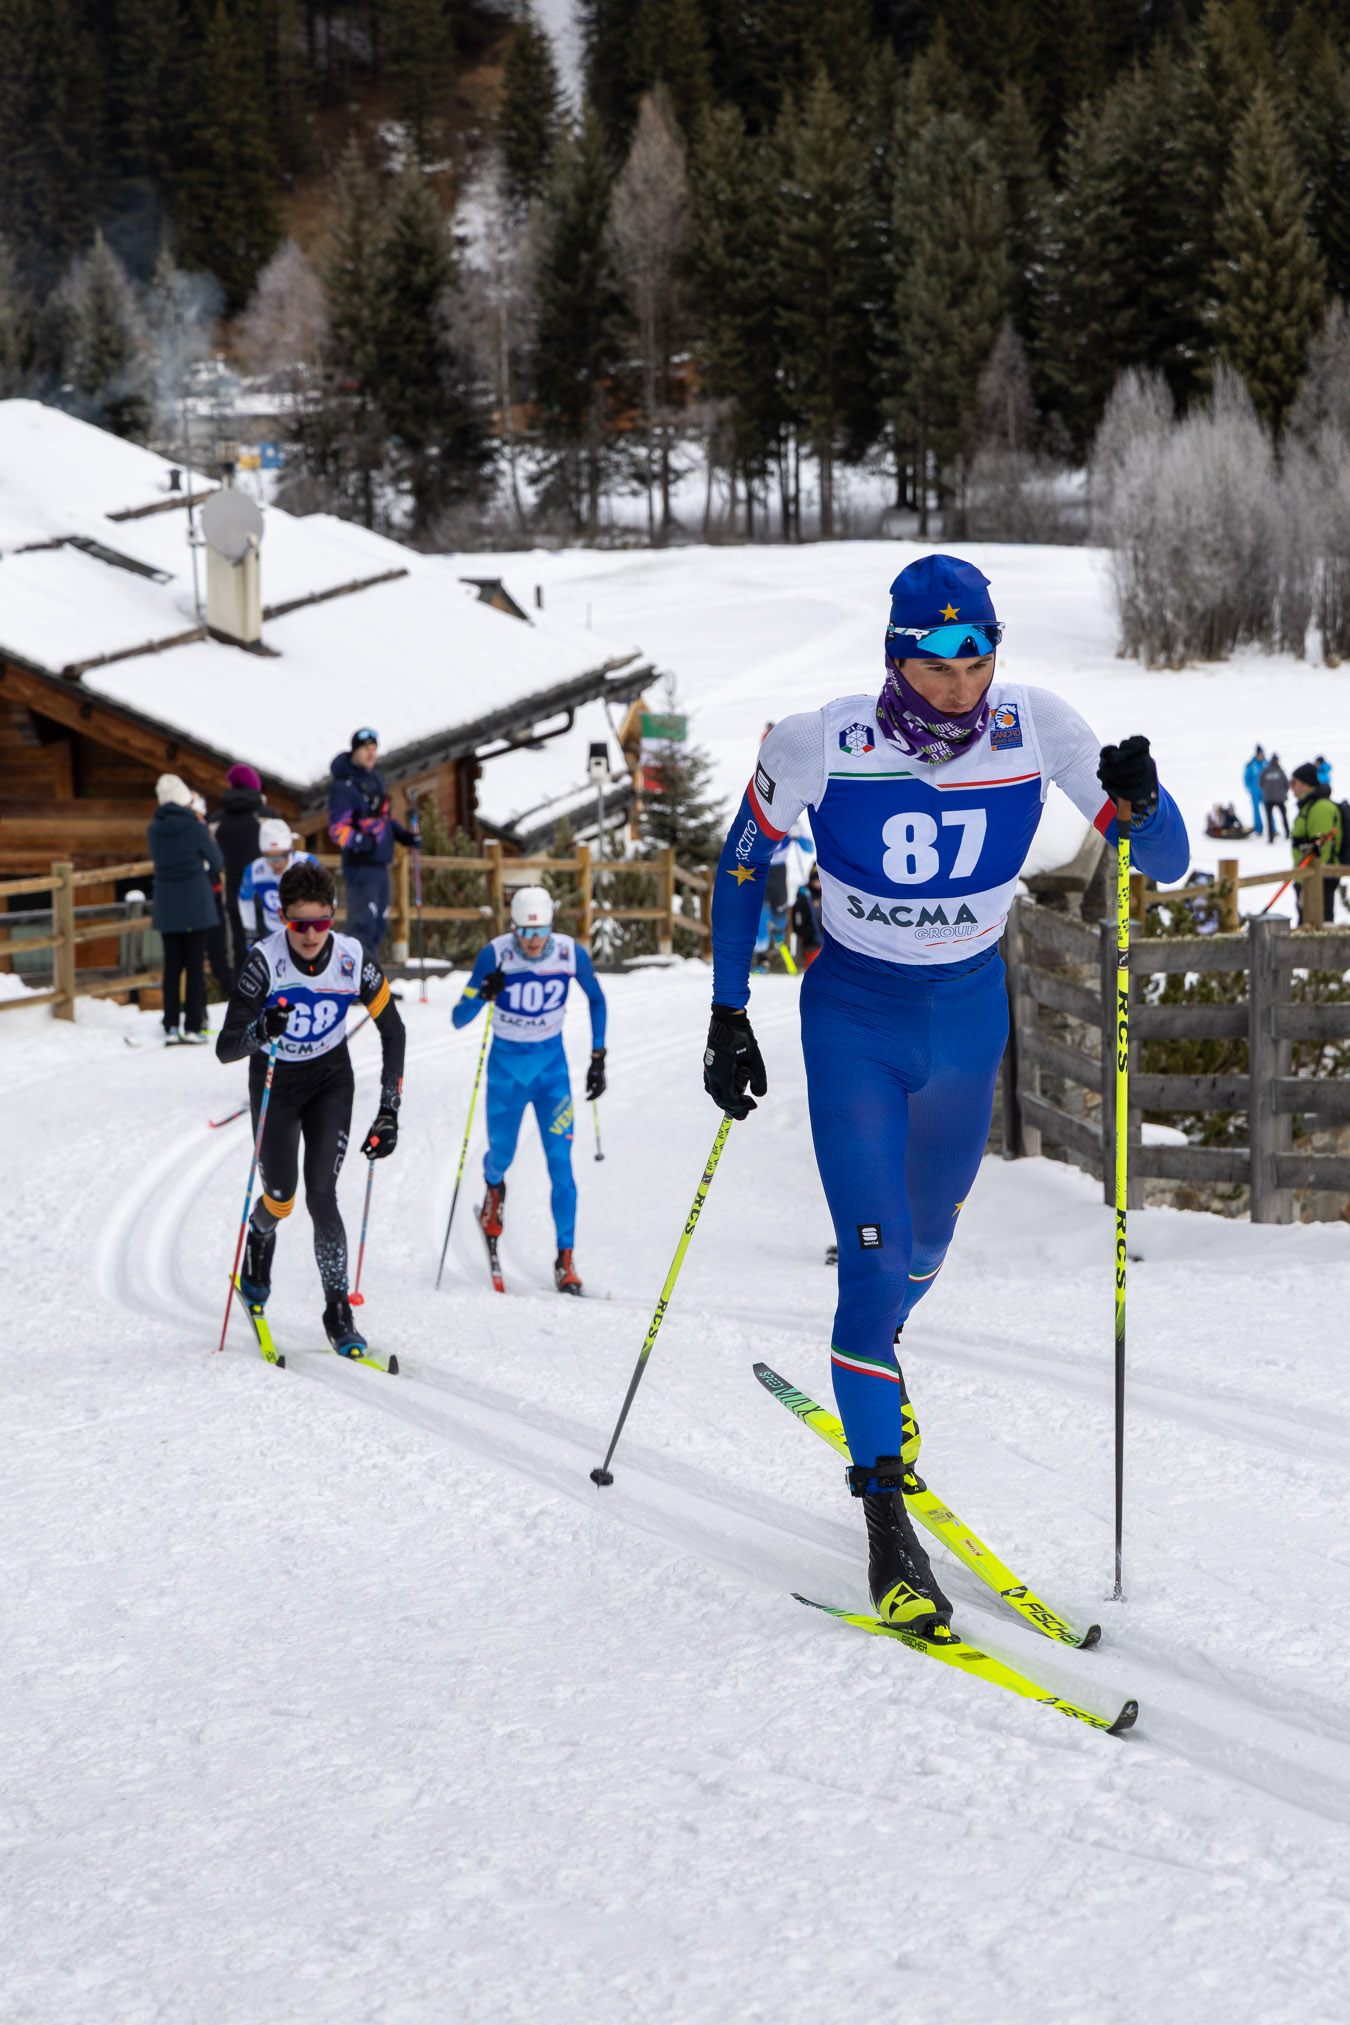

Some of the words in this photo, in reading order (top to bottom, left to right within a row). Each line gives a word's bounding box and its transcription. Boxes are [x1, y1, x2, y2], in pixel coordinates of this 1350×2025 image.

[845, 724, 867, 734] FISI
[928, 722, 957, 733] MOVE
[991, 729, 1021, 740] CANCRO
[921, 740, 949, 755] MOVE
[882, 808, 987, 885] 87
[847, 895, 978, 928] SACMA
[915, 925, 978, 940] GROUP
[504, 979, 565, 1013] 102
[286, 1000, 339, 1038] 68
[1118, 989, 1129, 1073] RCS
[685, 1191, 706, 1235] RCS
[1116, 1207, 1127, 1290] RCS
[648, 1298, 668, 1340] RCS
